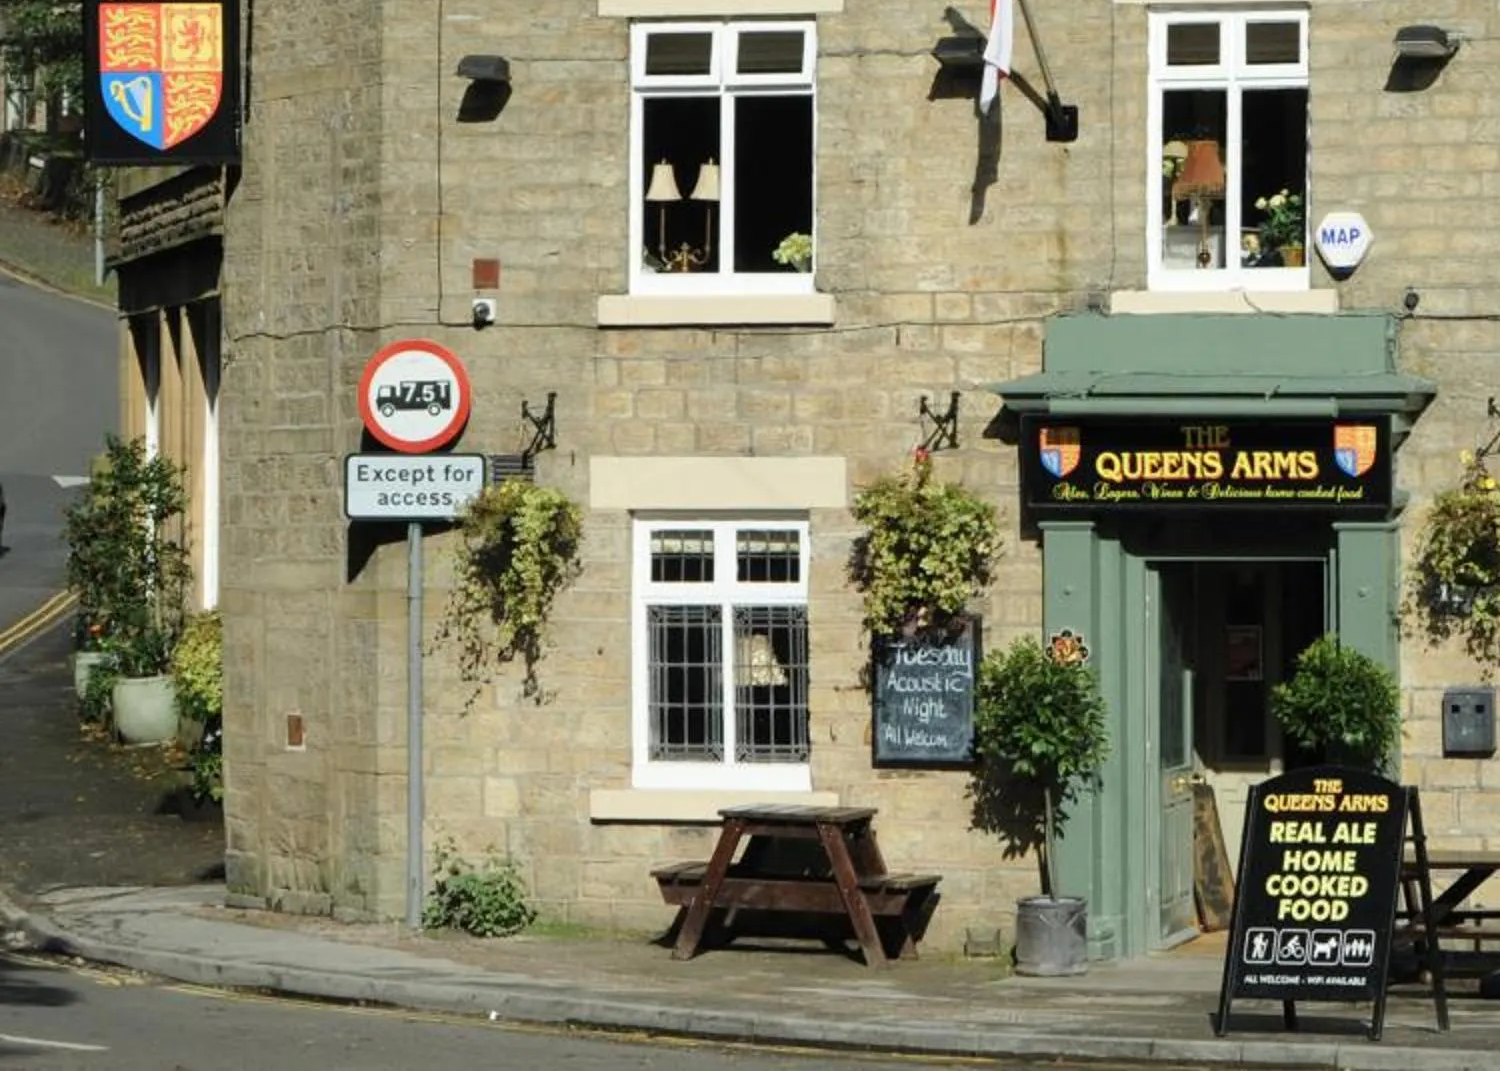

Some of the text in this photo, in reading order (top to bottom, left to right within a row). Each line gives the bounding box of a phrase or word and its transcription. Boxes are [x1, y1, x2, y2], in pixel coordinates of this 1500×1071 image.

[1321, 226, 1360, 245] MAP
[1181, 425, 1230, 448] THE
[357, 464, 474, 486] Except for
[1095, 452, 1319, 482] QUEENS ARMS
[377, 491, 453, 506] access
[1336, 485, 1362, 503] food
[889, 643, 973, 678] Tuesday
[887, 671, 965, 692] Acoustic
[903, 697, 947, 723] Night
[1313, 779, 1343, 793] THE
[1264, 794, 1389, 813] QUEENS ARMS
[1269, 822, 1377, 844] REAL ALE
[1283, 851, 1356, 872] HOME
[1265, 875, 1369, 898] COOKED
[1277, 899, 1349, 922] FOOD
[1244, 974, 1258, 985] ALL
[1260, 974, 1300, 986] WELCOME
[1325, 976, 1367, 986] AVAILABLE
